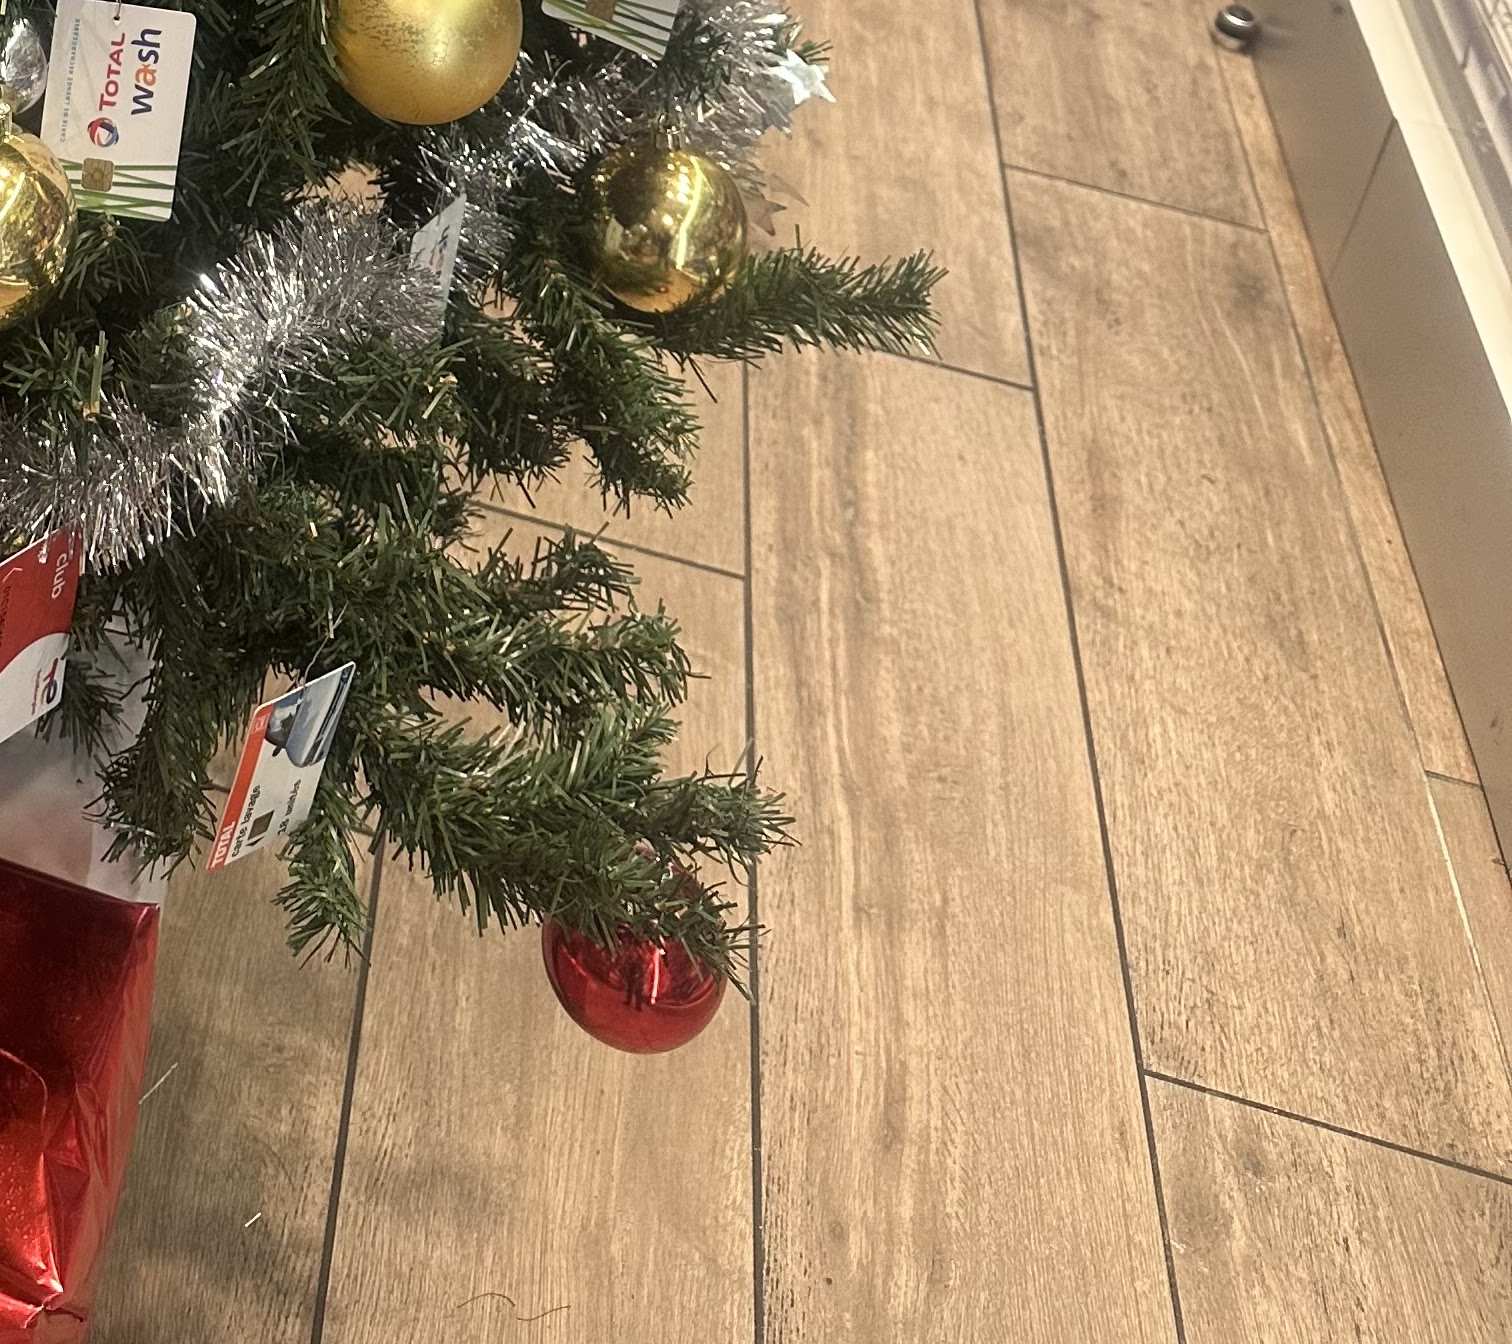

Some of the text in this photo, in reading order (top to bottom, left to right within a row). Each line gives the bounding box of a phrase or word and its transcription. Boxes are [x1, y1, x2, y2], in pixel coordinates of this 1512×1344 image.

[98, 32, 126, 112] TOTAL
[130, 27, 162, 116] wash
[51, 553, 69, 599] club
[231, 785, 261, 858] carte lavage
